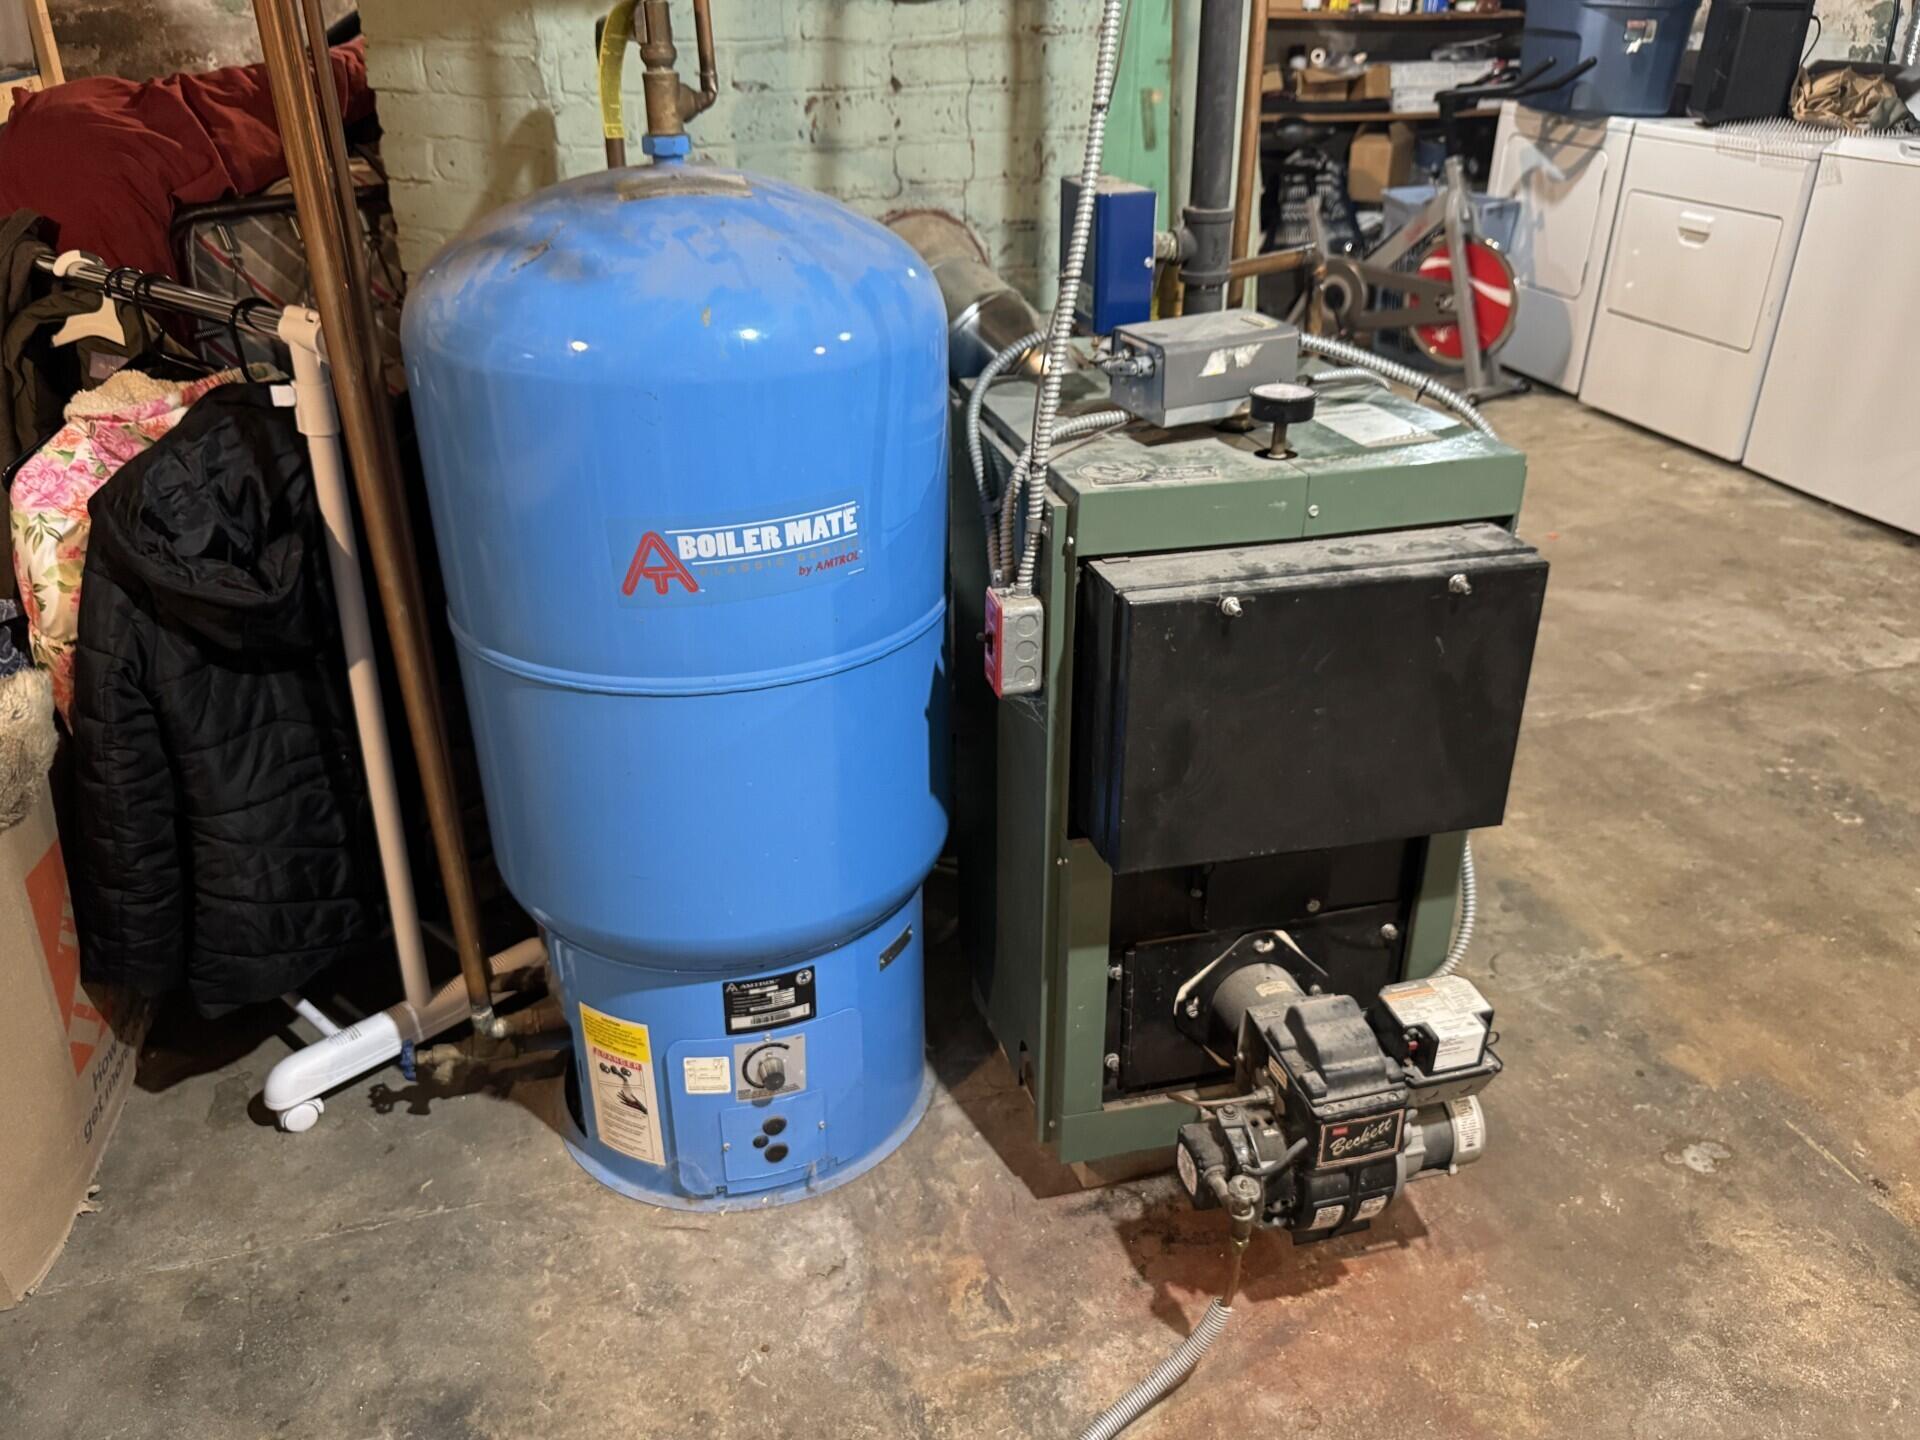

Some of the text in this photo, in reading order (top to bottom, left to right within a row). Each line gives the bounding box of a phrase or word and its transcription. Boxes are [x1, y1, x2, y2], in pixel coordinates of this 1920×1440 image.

[677, 506, 858, 560] BOILER MATE
[799, 550, 860, 577] by AMTROL
[84, 1094, 104, 1144] get
[1329, 1118, 1392, 1157] Beckett
